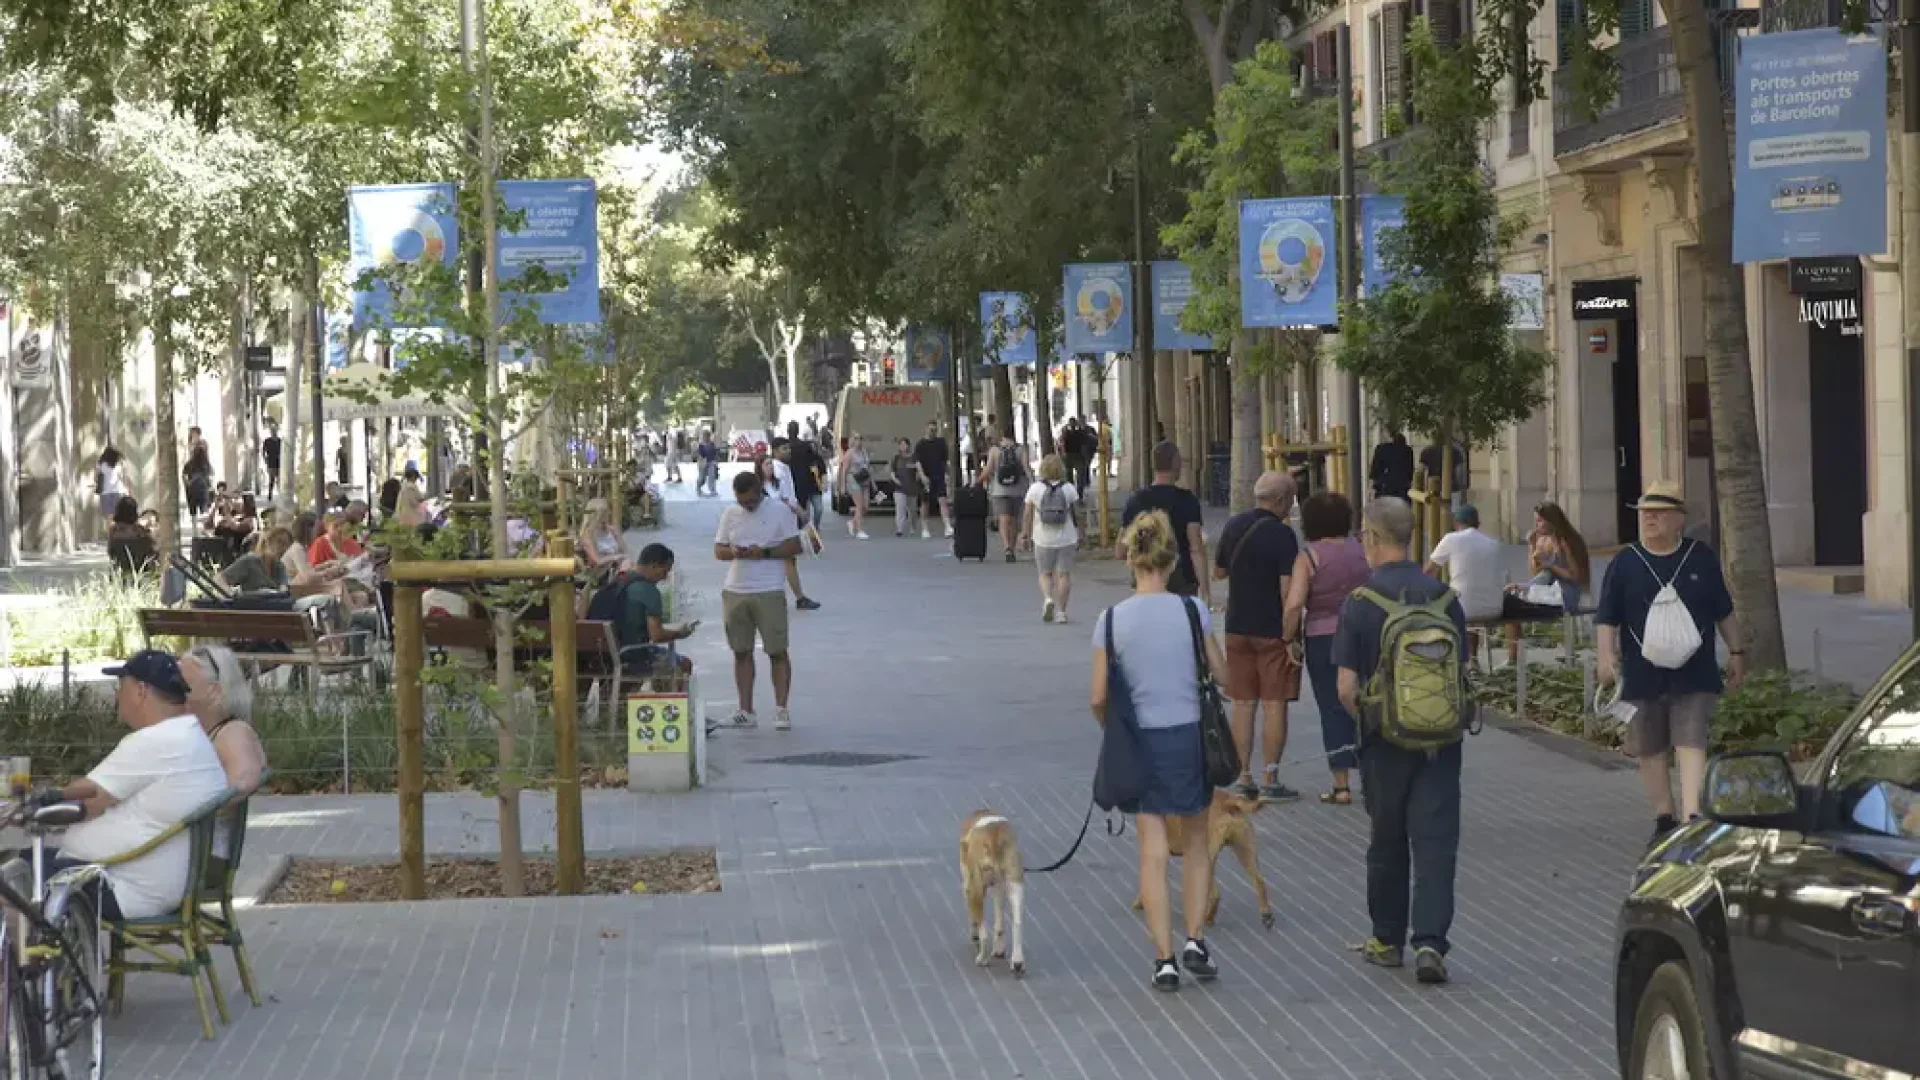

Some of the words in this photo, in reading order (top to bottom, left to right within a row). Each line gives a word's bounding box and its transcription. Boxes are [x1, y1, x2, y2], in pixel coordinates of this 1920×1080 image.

[1751, 75, 1796, 93] Portes
[1800, 70, 1860, 87] obertes
[1750, 93, 1769, 108] als
[1773, 85, 1852, 106] transports
[1750, 109, 1767, 125] de
[1769, 102, 1841, 122] Barcelona
[1798, 296, 1858, 329] ALQVIMIA
[861, 390, 923, 405] NACEX
